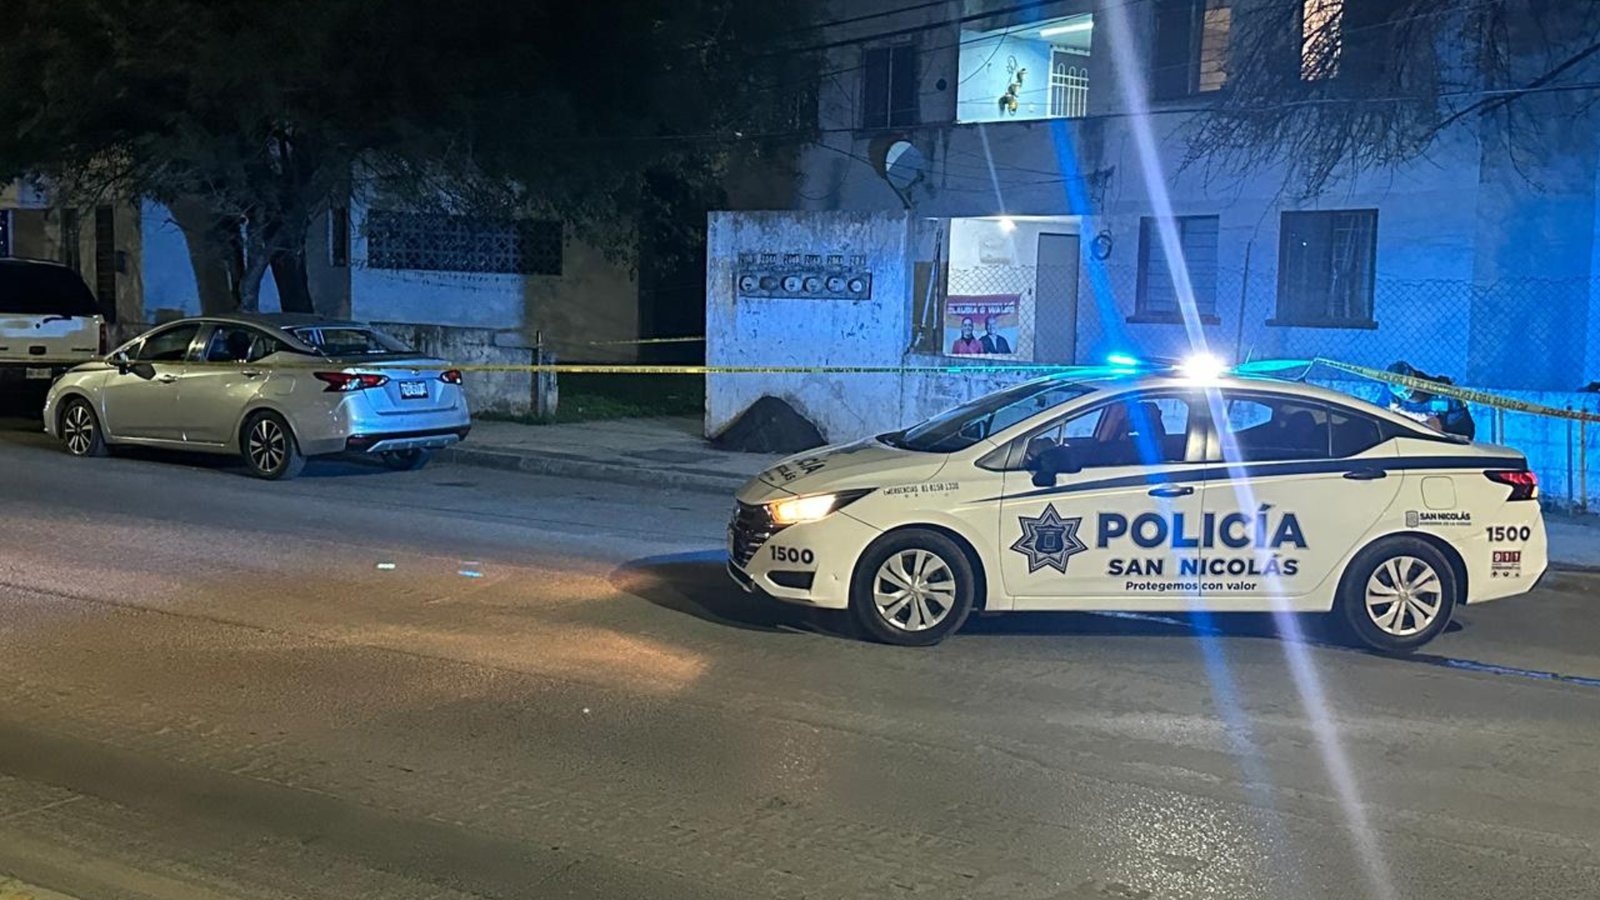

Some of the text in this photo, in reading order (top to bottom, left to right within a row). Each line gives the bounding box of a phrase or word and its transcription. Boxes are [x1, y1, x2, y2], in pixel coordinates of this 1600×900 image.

[1420, 510, 1471, 520] SAN NICOLÁS
[1095, 503, 1310, 549] POLICÍA
[1485, 526, 1531, 542] 1500
[770, 545, 814, 565] 1500
[1494, 552, 1520, 562] 911
[1108, 553, 1298, 576] SAN NICOLÁS
[1125, 581, 1257, 592] Protegemos con valor
